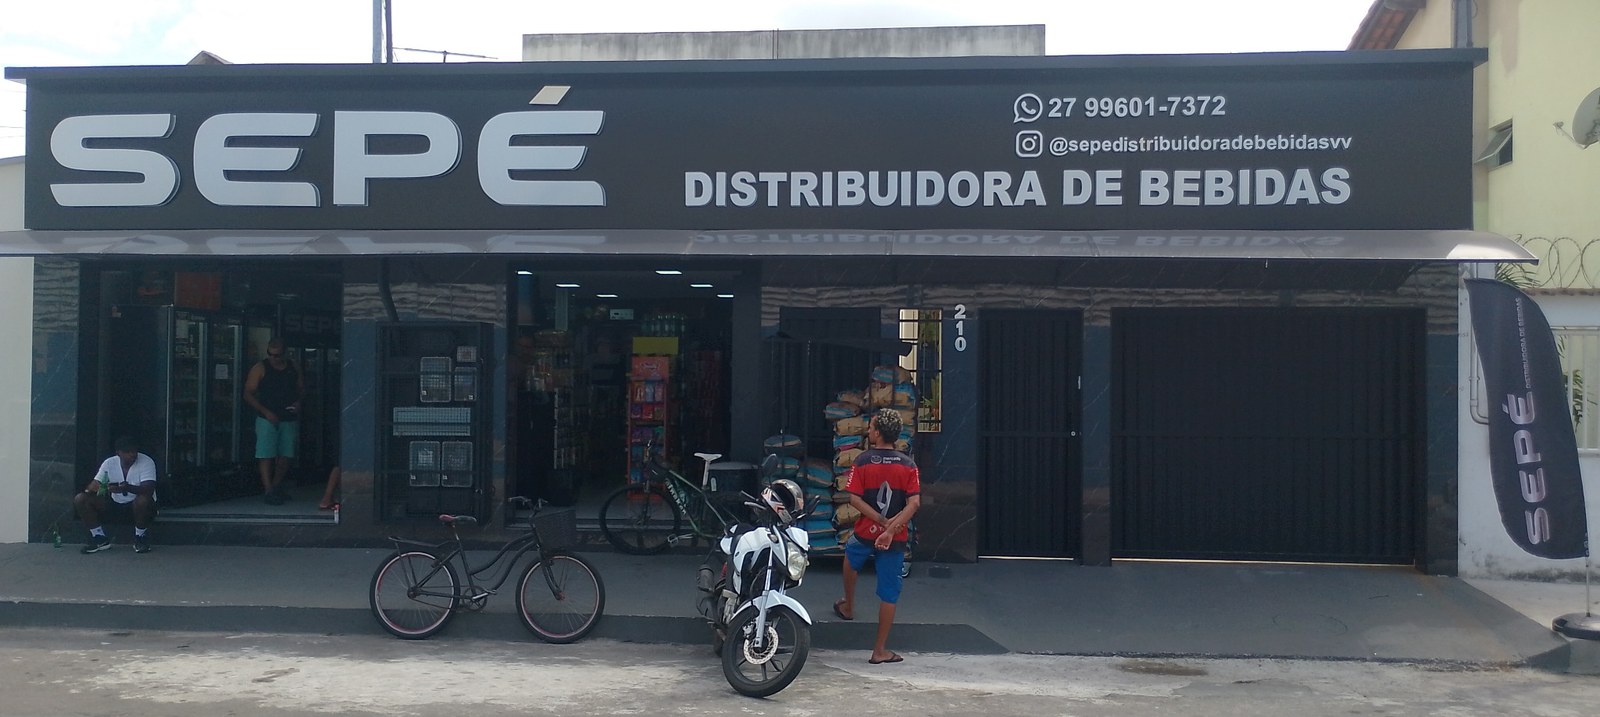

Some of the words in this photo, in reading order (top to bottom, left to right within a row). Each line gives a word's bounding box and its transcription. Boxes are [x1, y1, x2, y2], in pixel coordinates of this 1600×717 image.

[1047, 97, 1077, 118] 27
[1084, 96, 1226, 118] 99601-7372
[49, 85, 604, 207] SEPÉ
[1049, 134, 1353, 156] @sepedistribuidoradebebidasvv
[685, 171, 1047, 207] DISTRIBUIDORA
[1062, 170, 1123, 206] DE
[1138, 168, 1351, 206] BEBIDAS
[954, 303, 967, 352] 210
[1518, 327, 1526, 337] DE
[1519, 337, 1531, 389] DISTRIBUIDORA
[1503, 392, 1549, 545] SEPÉ
